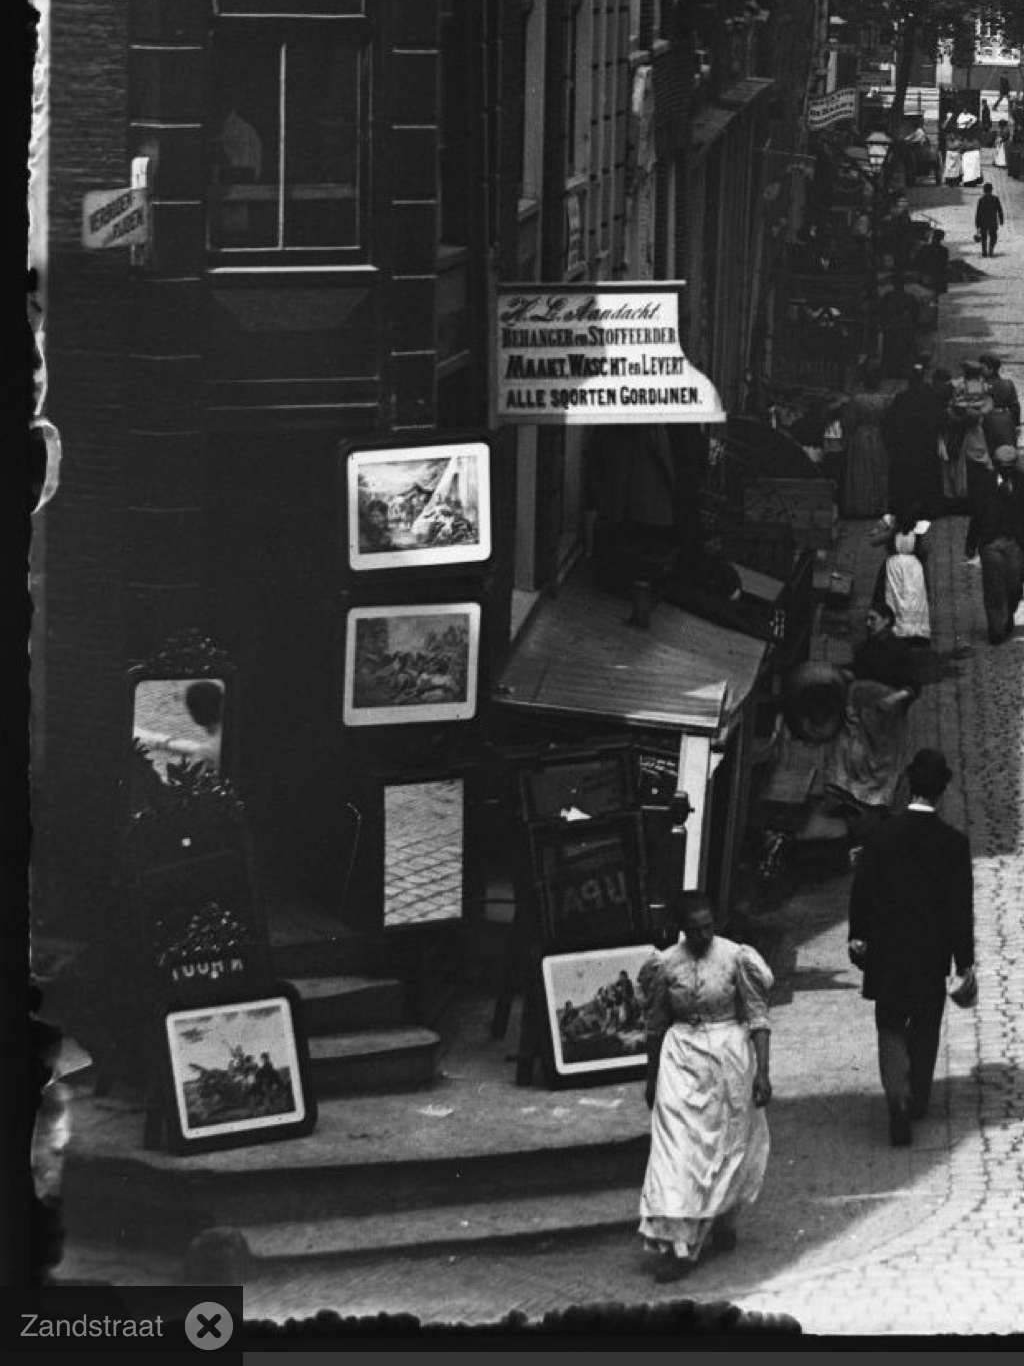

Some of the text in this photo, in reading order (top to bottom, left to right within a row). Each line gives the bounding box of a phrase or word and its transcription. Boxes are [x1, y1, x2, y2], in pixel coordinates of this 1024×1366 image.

[502, 328, 573, 348] BEHANGER
[589, 326, 676, 348] STOFFEERDER
[568, 354, 627, 379] WASCHT
[628, 361, 641, 375] en
[641, 354, 685, 376] LEVERT
[506, 389, 546, 409] ALLE
[550, 387, 616, 409] SOORTEN
